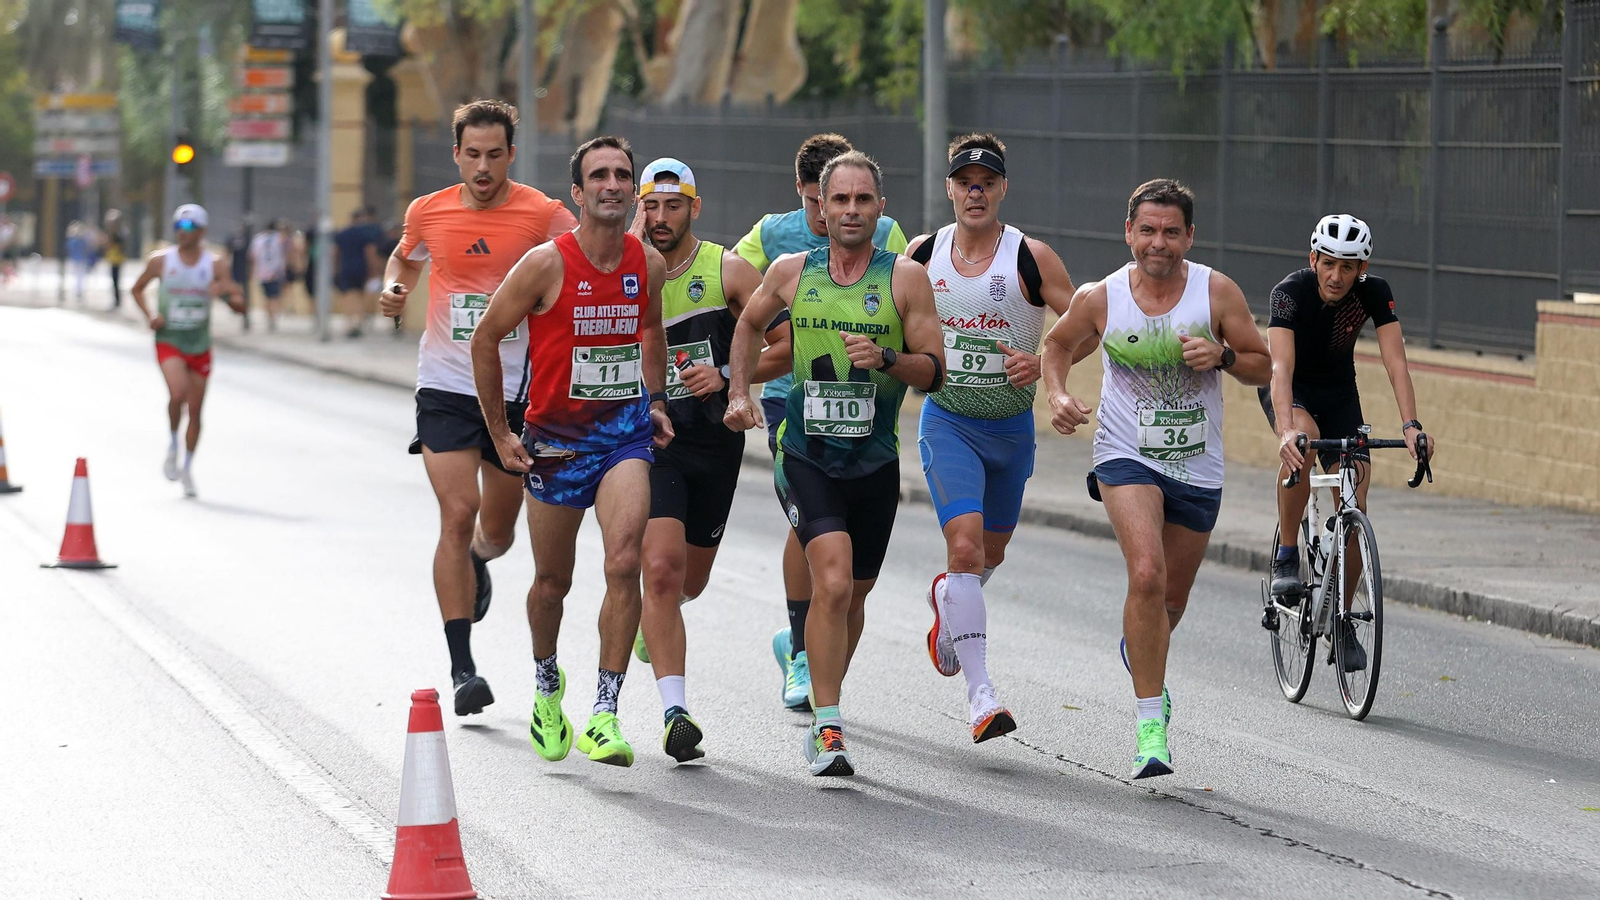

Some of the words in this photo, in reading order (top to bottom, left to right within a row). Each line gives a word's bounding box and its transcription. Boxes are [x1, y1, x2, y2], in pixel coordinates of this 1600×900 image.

[573, 306, 596, 318] CLUB
[597, 304, 639, 317] ATLETISMO
[573, 318, 638, 336] TREBUJENA
[796, 317, 810, 328] C.D.
[812, 318, 828, 330] LA
[831, 319, 890, 335] MOLINERA
[962, 353, 987, 371] 89
[599, 364, 620, 383] 11
[823, 400, 860, 419] 110
[1163, 428, 1189, 446] 36
